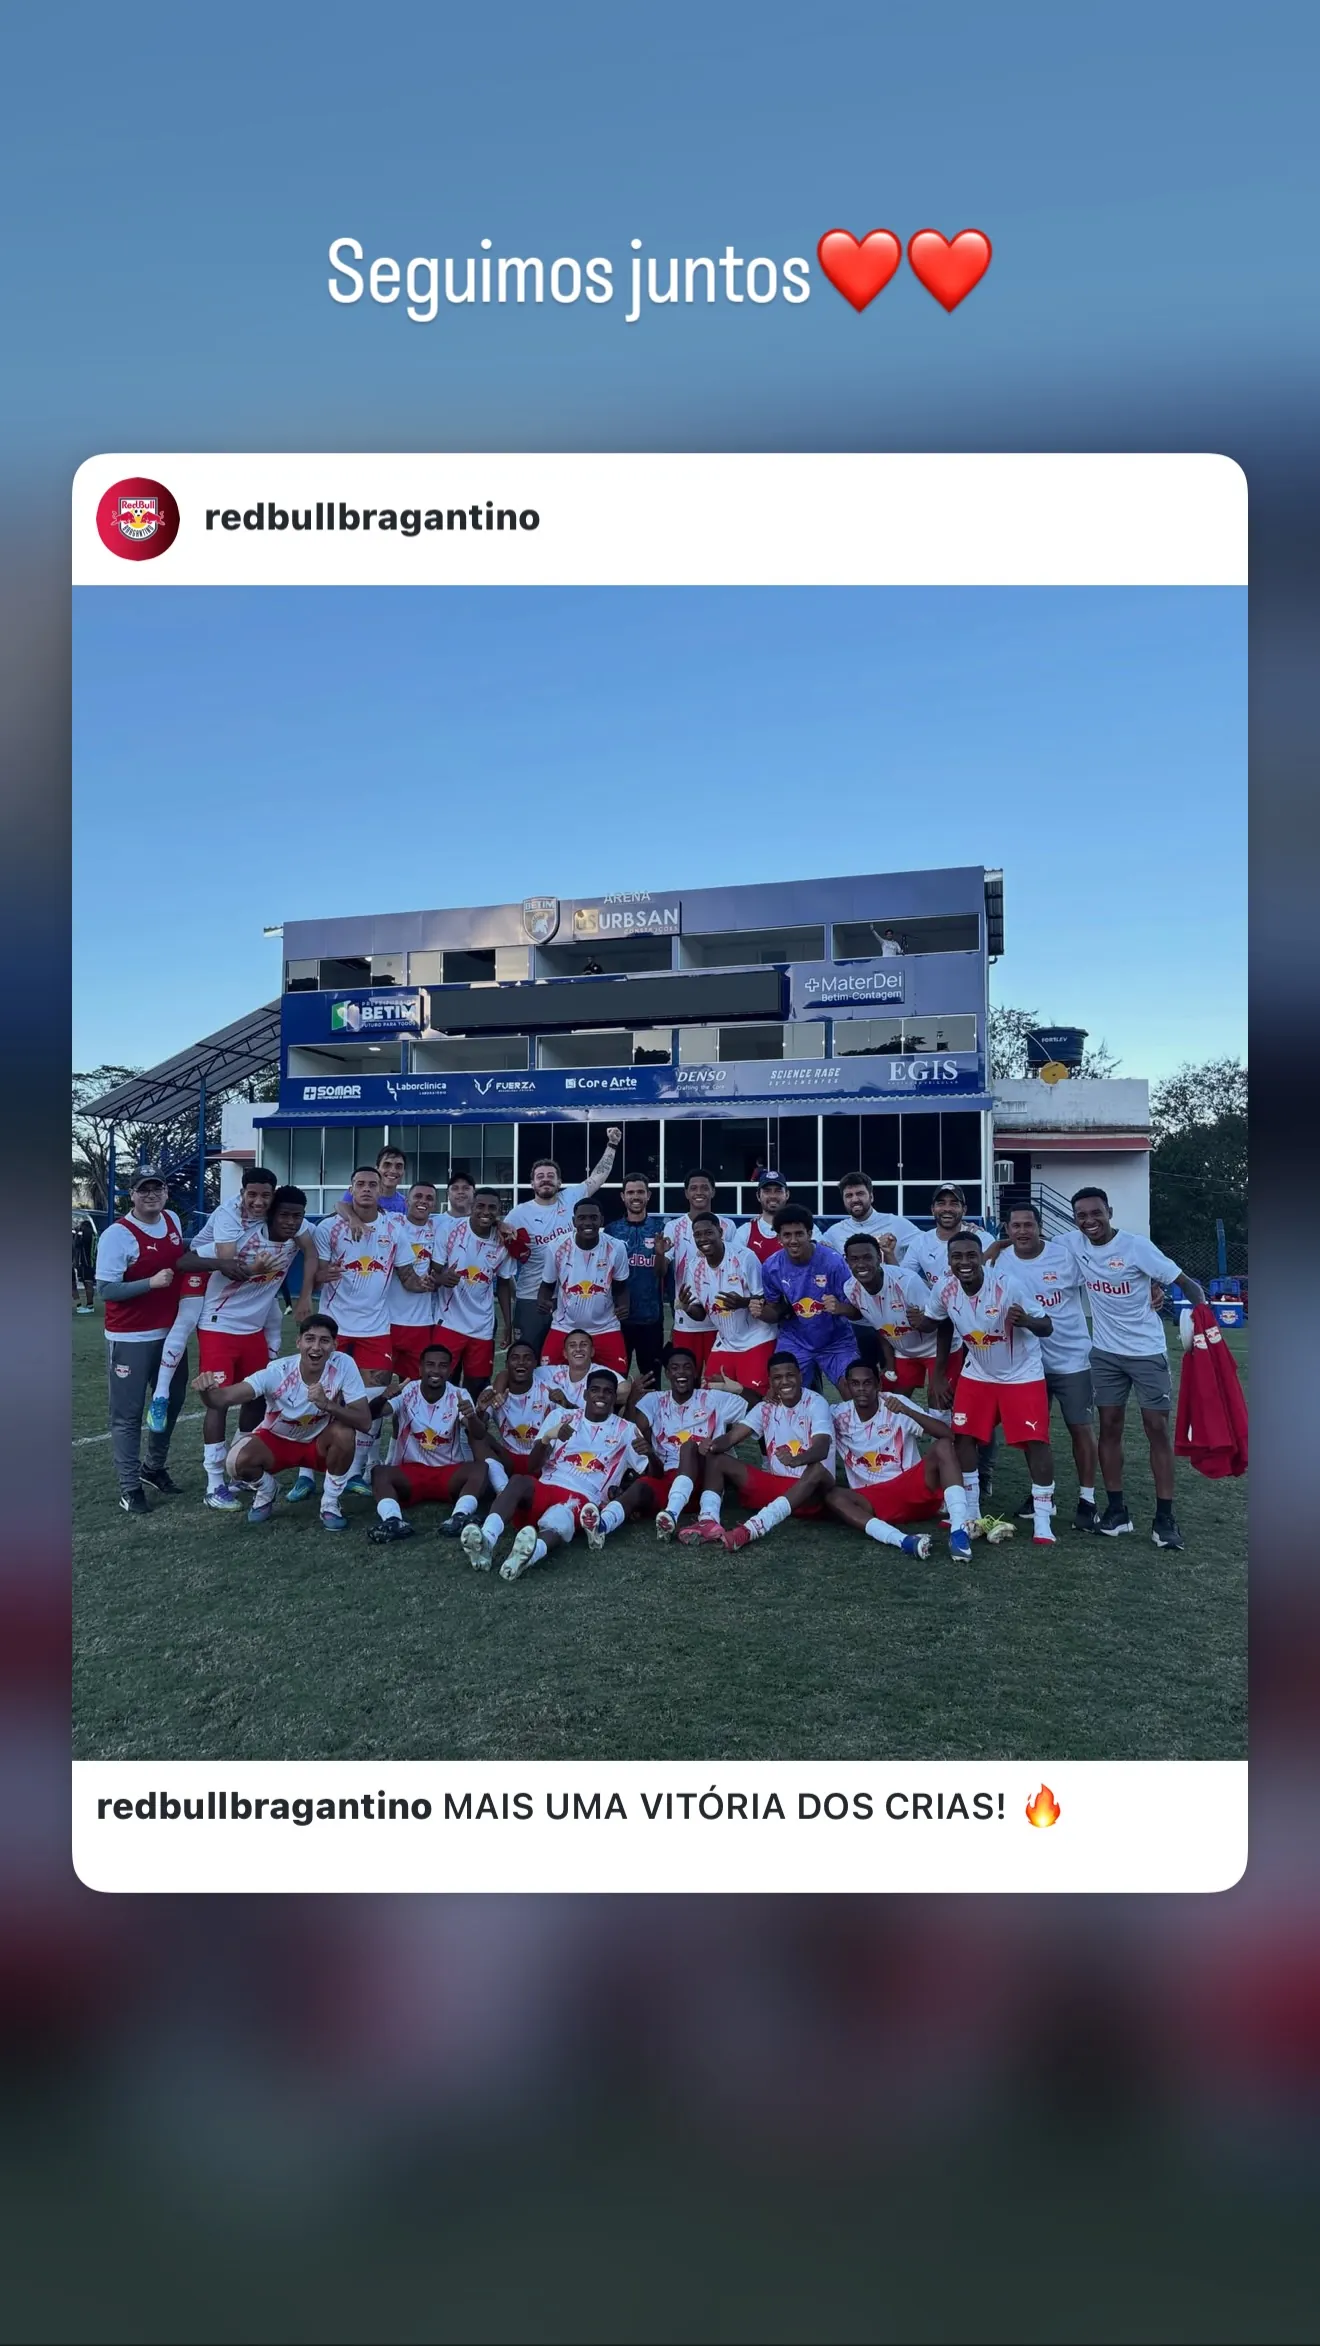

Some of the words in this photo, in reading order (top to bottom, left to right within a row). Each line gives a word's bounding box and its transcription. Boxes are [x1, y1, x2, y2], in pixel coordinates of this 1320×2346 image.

[603, 891, 651, 905] ARENA
[525, 901, 555, 911] BETIM
[600, 908, 678, 930] URBSAN
[361, 1003, 416, 1020] BETIM
[677, 1070, 728, 1083] DENSO
[770, 1069, 811, 1080] SCIENCE
[814, 1067, 841, 1078] RAGE
[888, 1059, 959, 1082] EGIS
[495, 1081, 536, 1090] FUERZA
[609, 1076, 638, 1087] Arte
[317, 1085, 362, 1096] SOMAR
[1102, 1280, 1131, 1295] Bull
